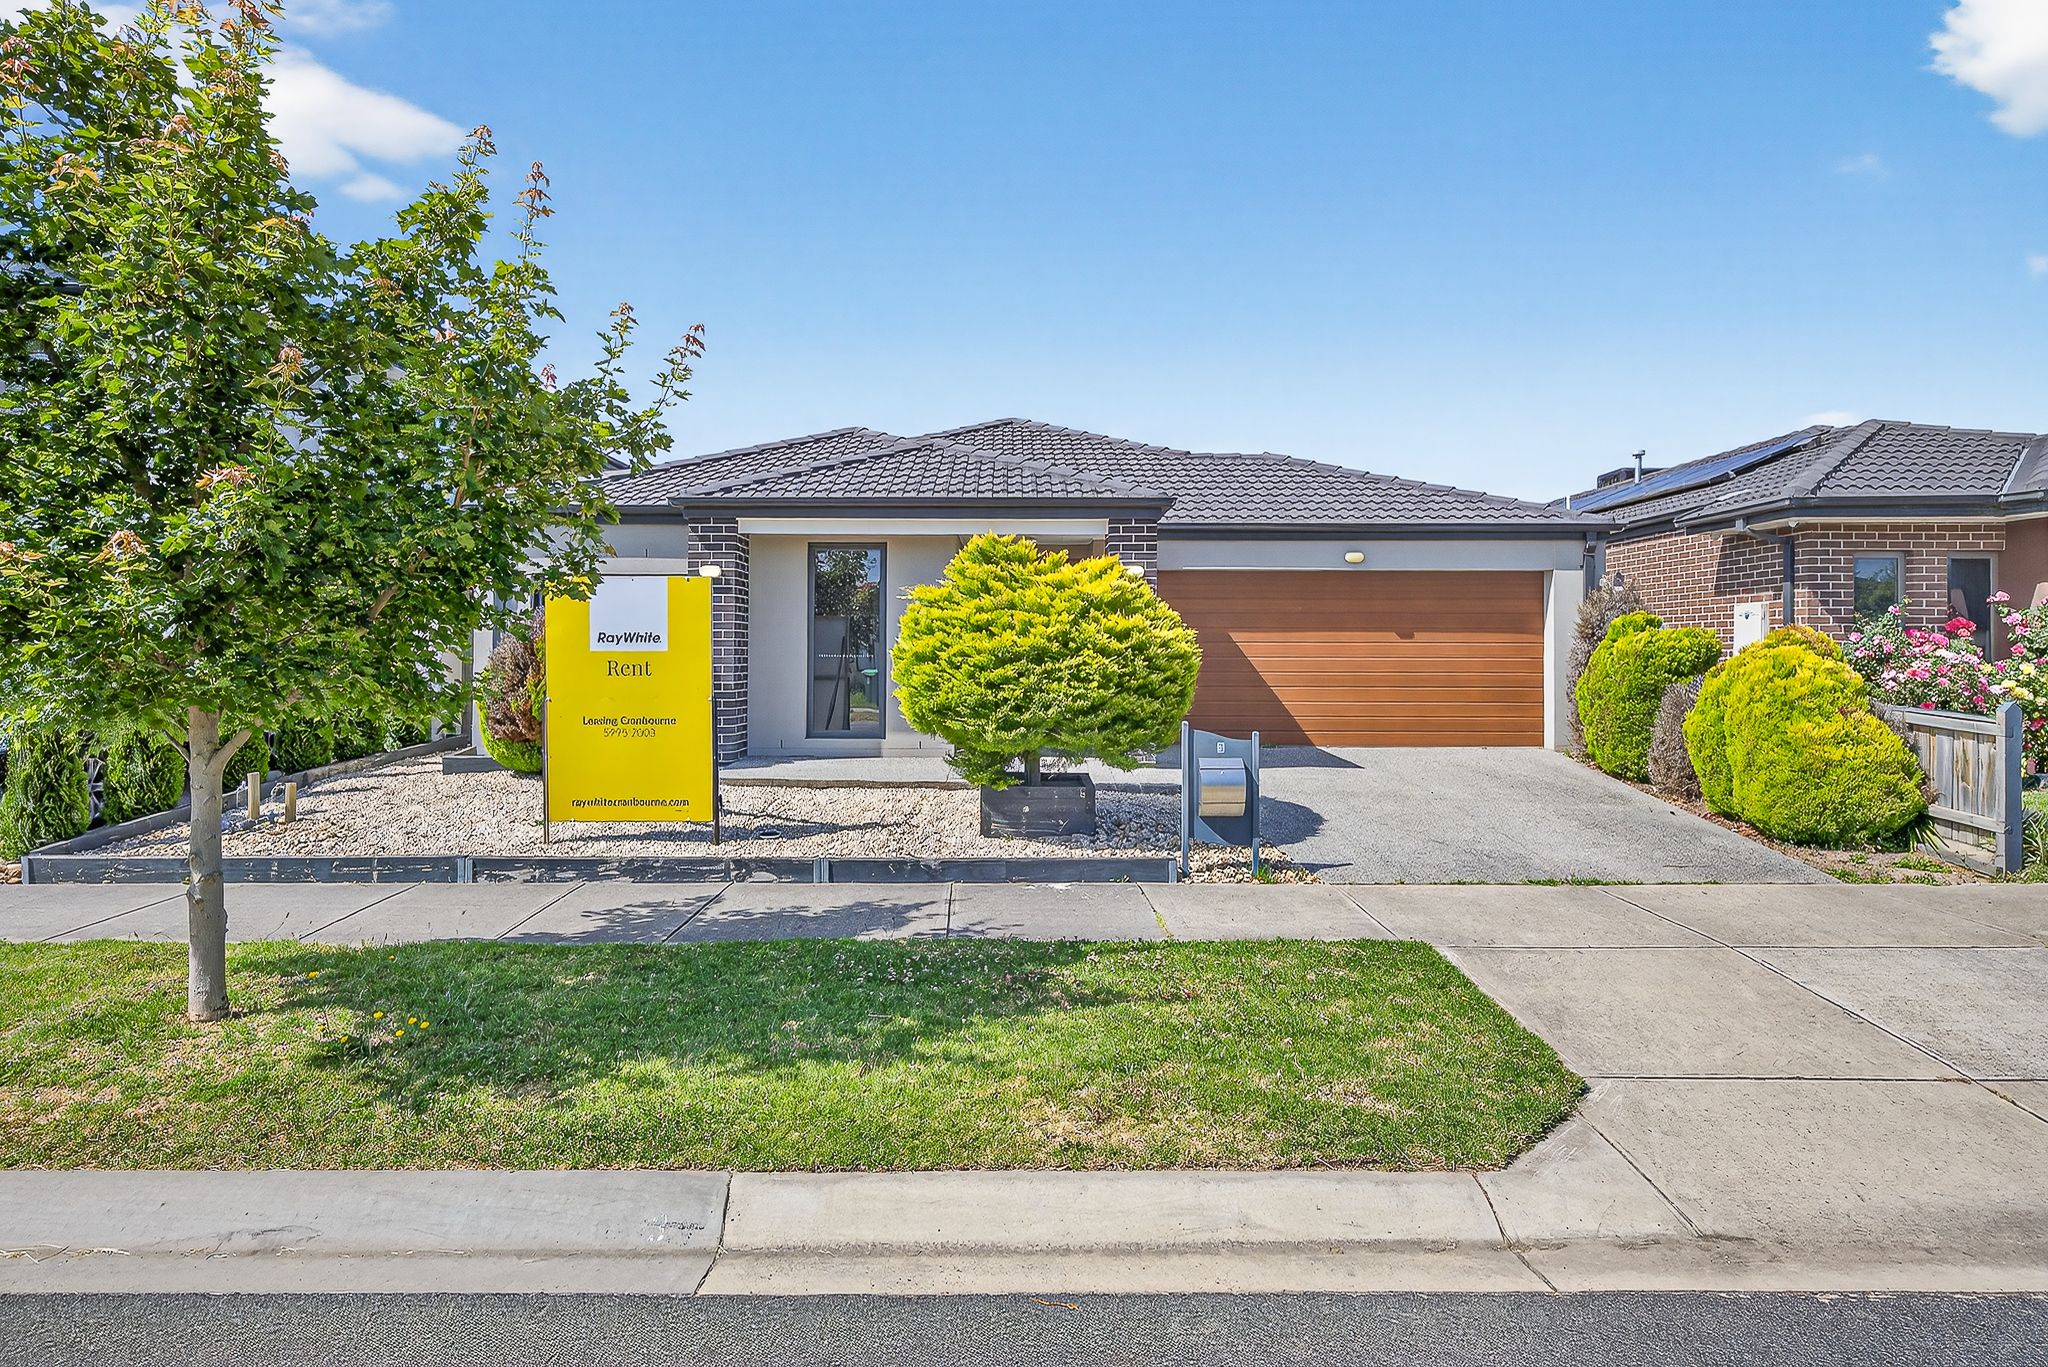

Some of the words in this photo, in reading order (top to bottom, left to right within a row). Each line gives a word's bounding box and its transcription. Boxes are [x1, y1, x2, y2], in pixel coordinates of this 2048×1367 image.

[607, 660, 652, 676] Rent
[582, 716, 618, 726] Leasing
[620, 716, 676, 725] Cranbourne
[571, 797, 690, 808] raywhitecranbourne.com
